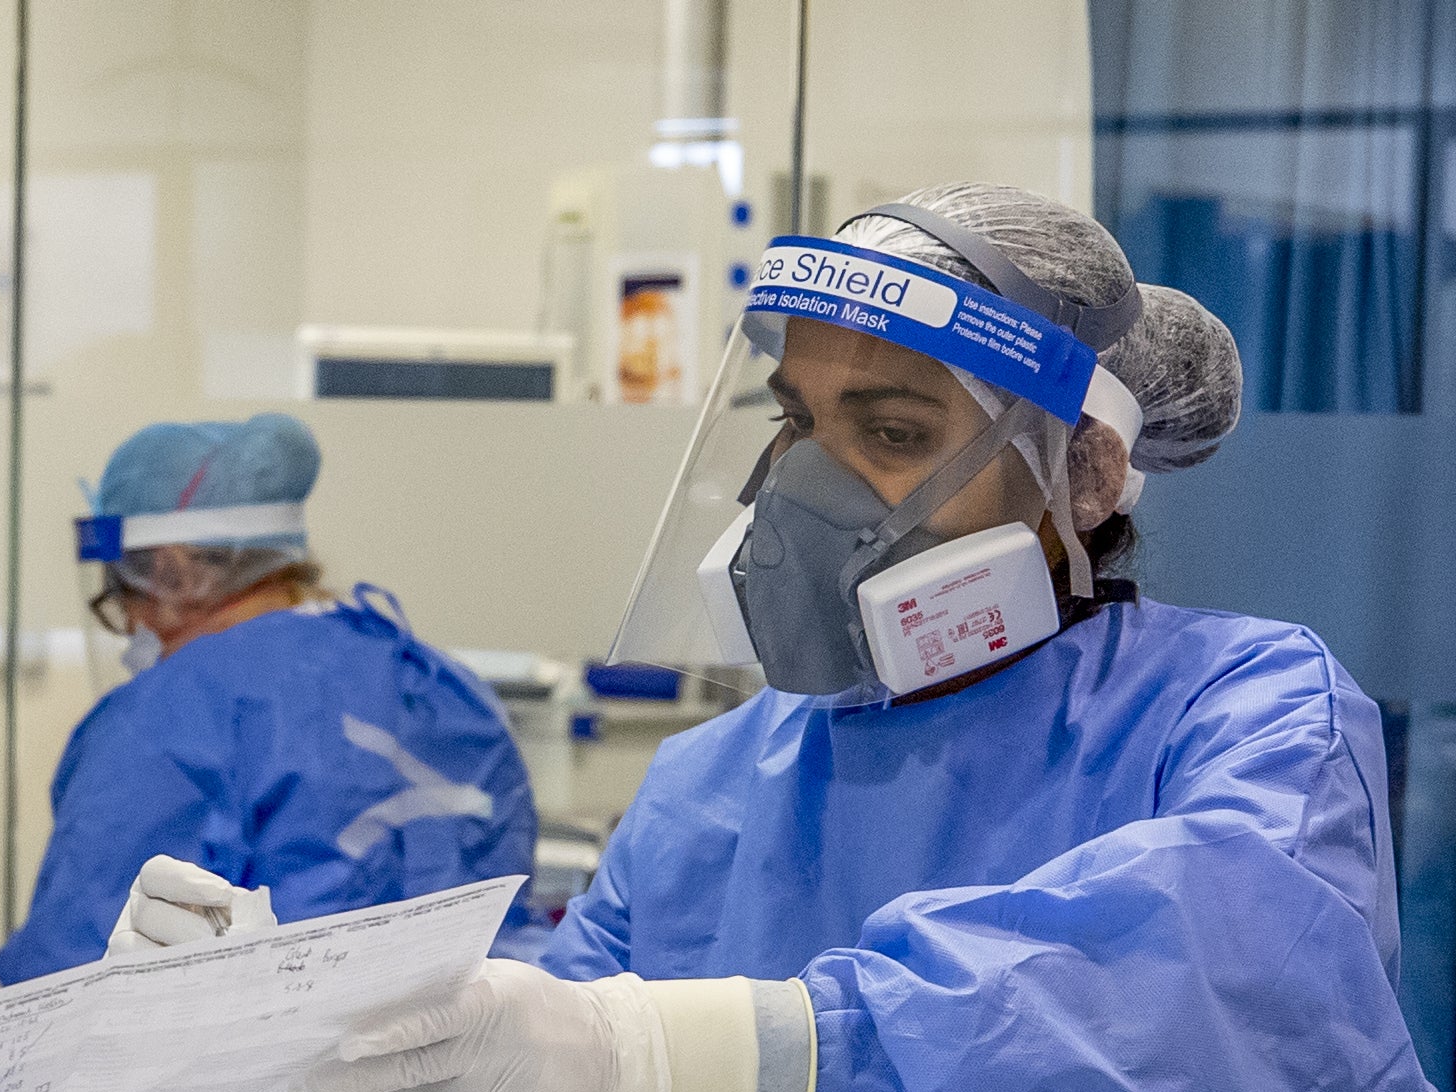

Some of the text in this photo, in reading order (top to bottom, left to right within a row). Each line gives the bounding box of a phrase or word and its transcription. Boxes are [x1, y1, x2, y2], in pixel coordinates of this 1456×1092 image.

[755, 253, 910, 307] ce Shield
[746, 290, 890, 332] ective isolation Mask
[963, 296, 978, 310] Use
[1019, 321, 1043, 340] Please
[984, 321, 997, 334] the
[996, 328, 1016, 342] outer
[952, 322, 988, 345] Protective
[1023, 356, 1041, 374] using
[897, 598, 917, 613] 3M
[900, 610, 923, 626] 6035
[982, 624, 1005, 640] 6035
[988, 636, 1008, 652] 3M
